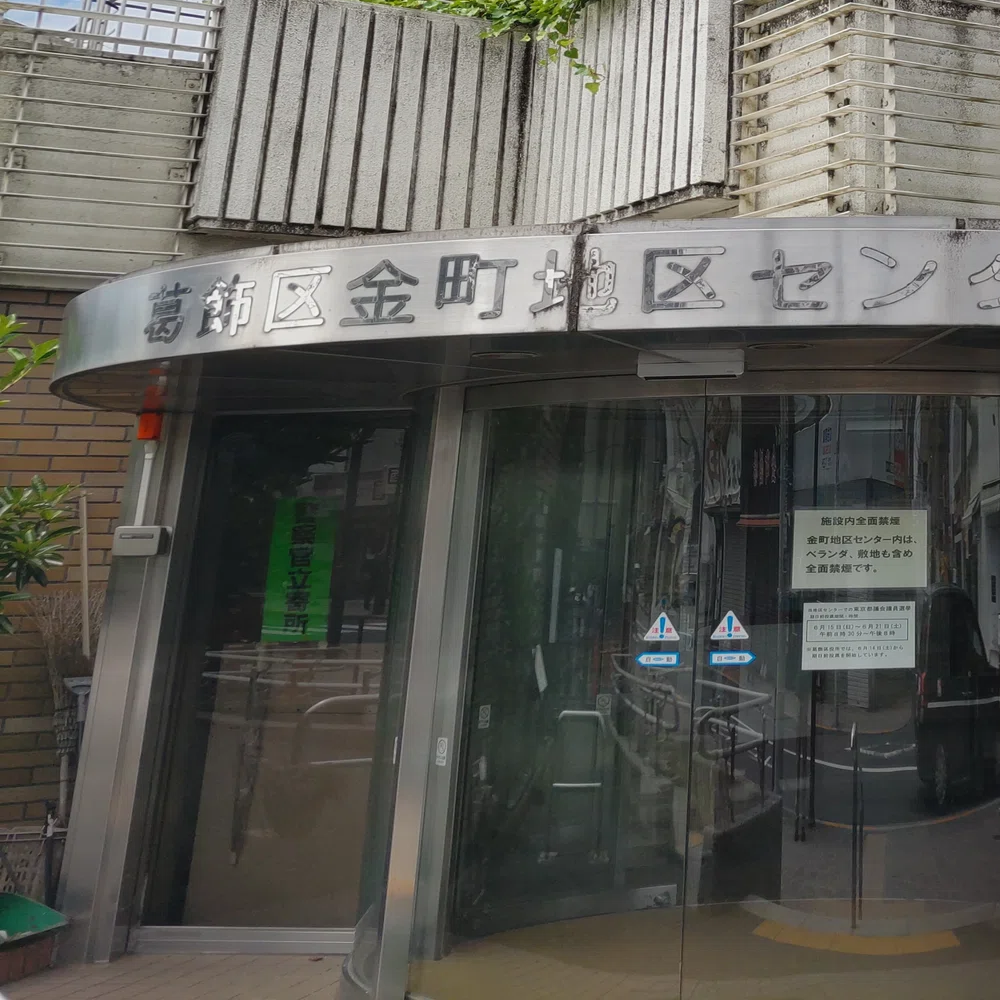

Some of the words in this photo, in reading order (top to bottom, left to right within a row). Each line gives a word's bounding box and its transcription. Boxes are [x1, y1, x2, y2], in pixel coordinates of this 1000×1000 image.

[820, 516, 901, 526] 施設内全面禁煙
[805, 563, 878, 574] 全面禁煙です。
